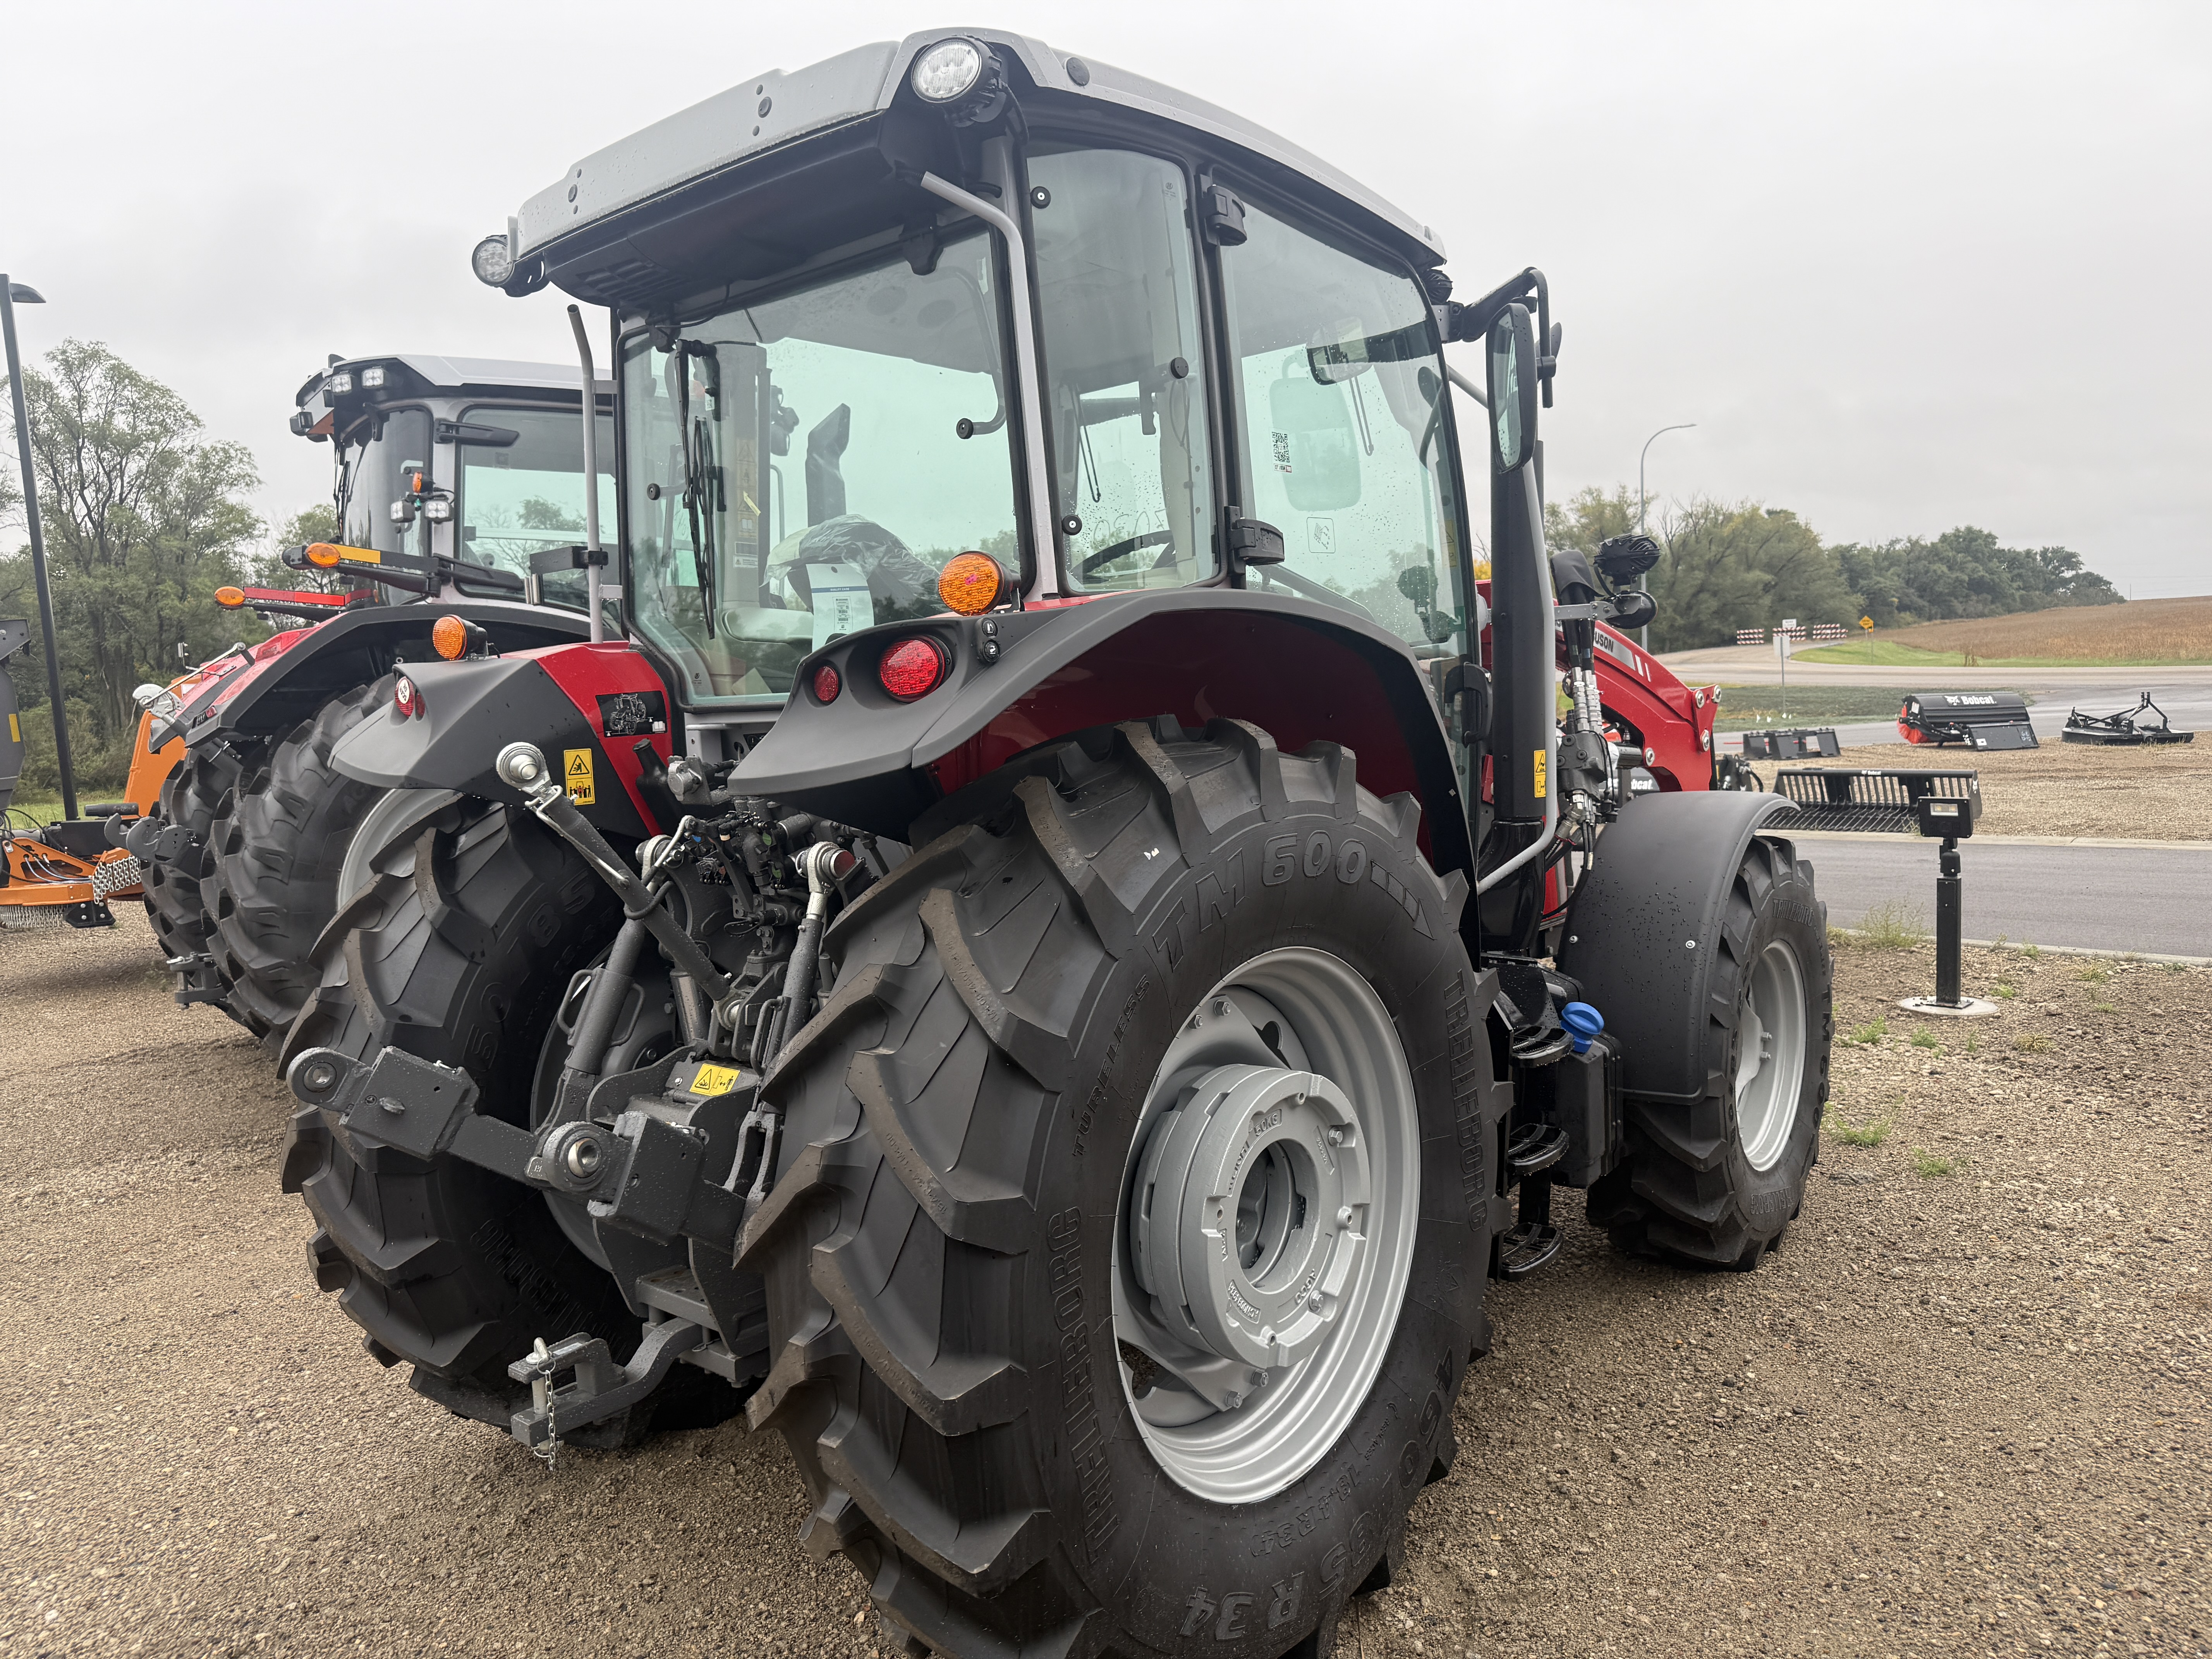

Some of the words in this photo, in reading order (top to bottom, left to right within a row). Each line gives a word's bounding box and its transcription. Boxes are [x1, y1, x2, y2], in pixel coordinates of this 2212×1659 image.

[1595, 631, 1614, 653] USON
[1960, 696, 1995, 705] Bobcat
[1631, 778, 1652, 790] bcat
[1152, 847, 1247, 973] TM
[1262, 830, 1367, 887] 600
[1072, 974, 1151, 1157] TUBELESS
[1443, 968, 1488, 1232] TRELLEBORG
[1294, 1268, 1316, 1306] AGCO
[1047, 1205, 1121, 1566] TRELLEBORG
